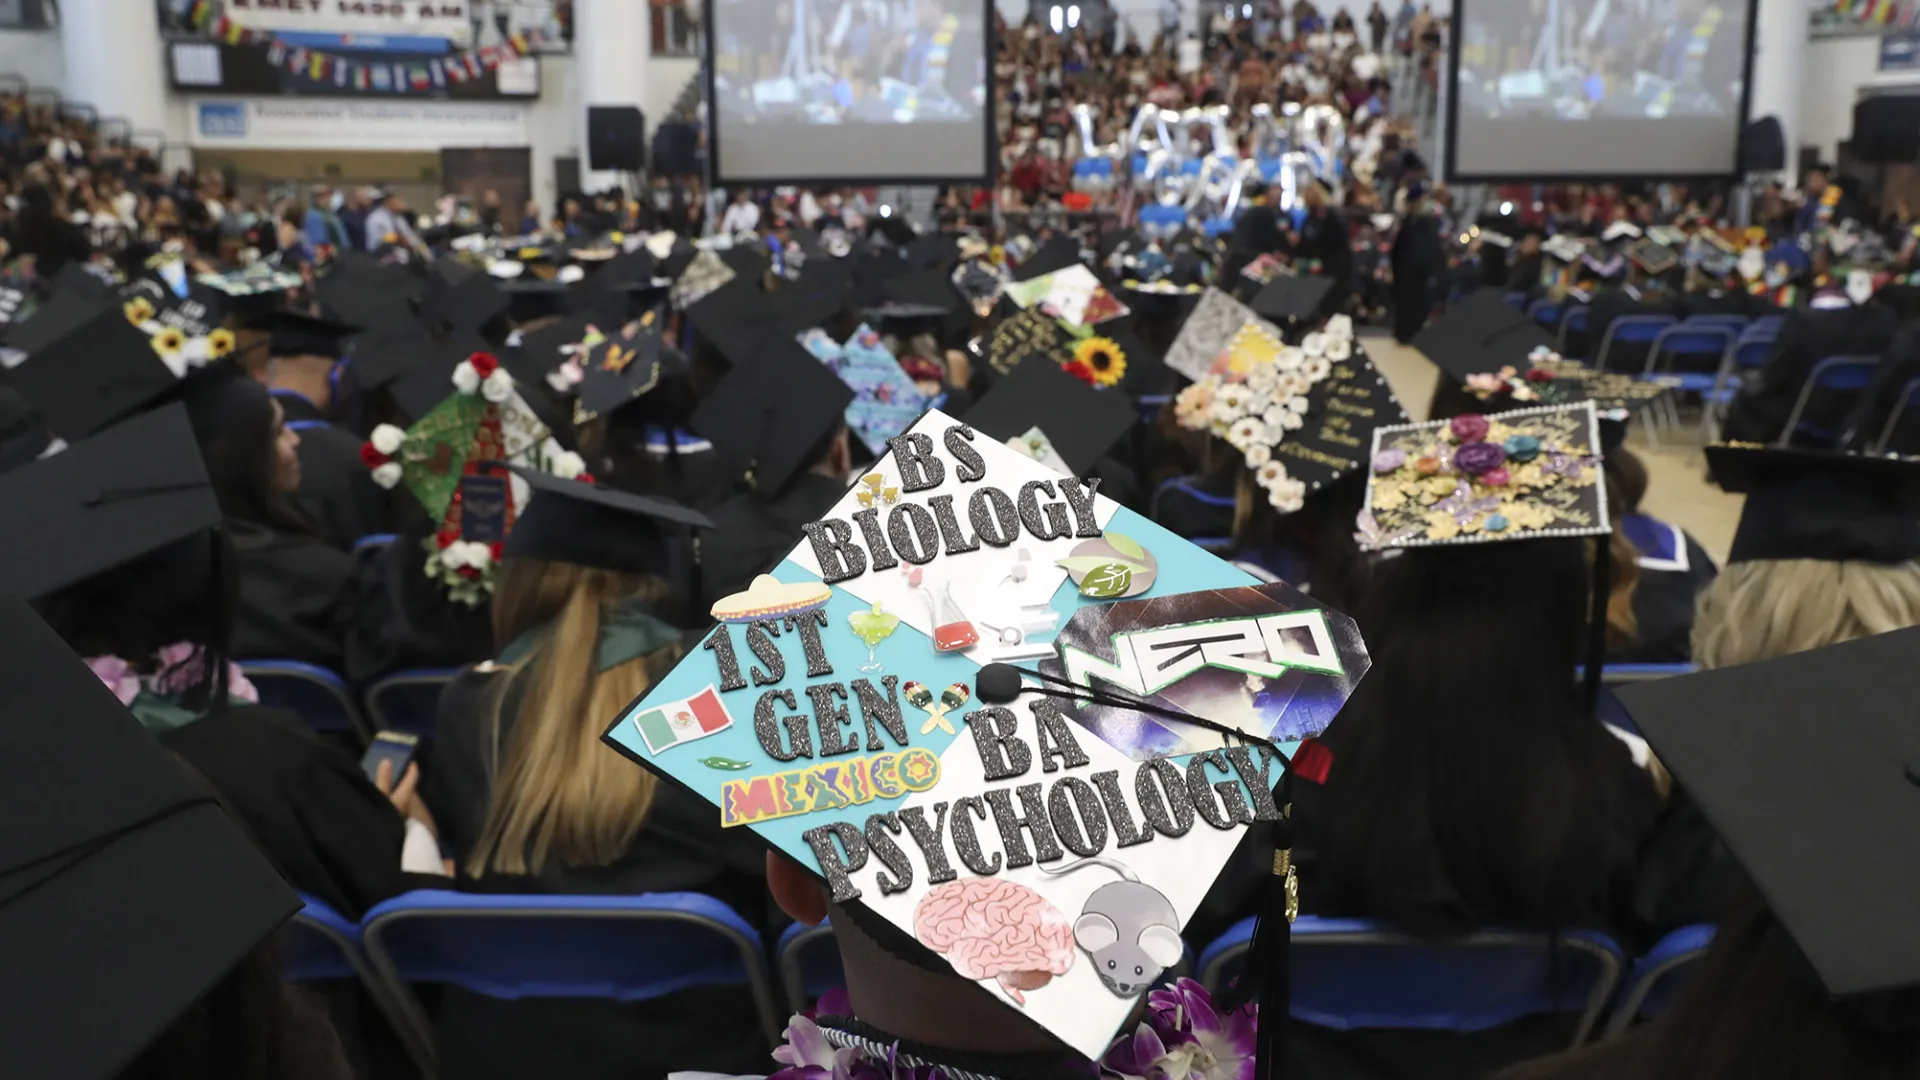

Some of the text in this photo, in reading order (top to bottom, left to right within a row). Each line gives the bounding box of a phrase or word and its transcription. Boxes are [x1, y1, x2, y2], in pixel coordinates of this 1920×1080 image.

[802, 476, 1102, 584] BIOLOGY
[704, 609, 834, 692] 1ST
[753, 675, 909, 762] GEN
[964, 699, 1090, 782] BA
[722, 750, 940, 826] MEXICO
[802, 747, 1285, 901] PSYCHOLOGY
